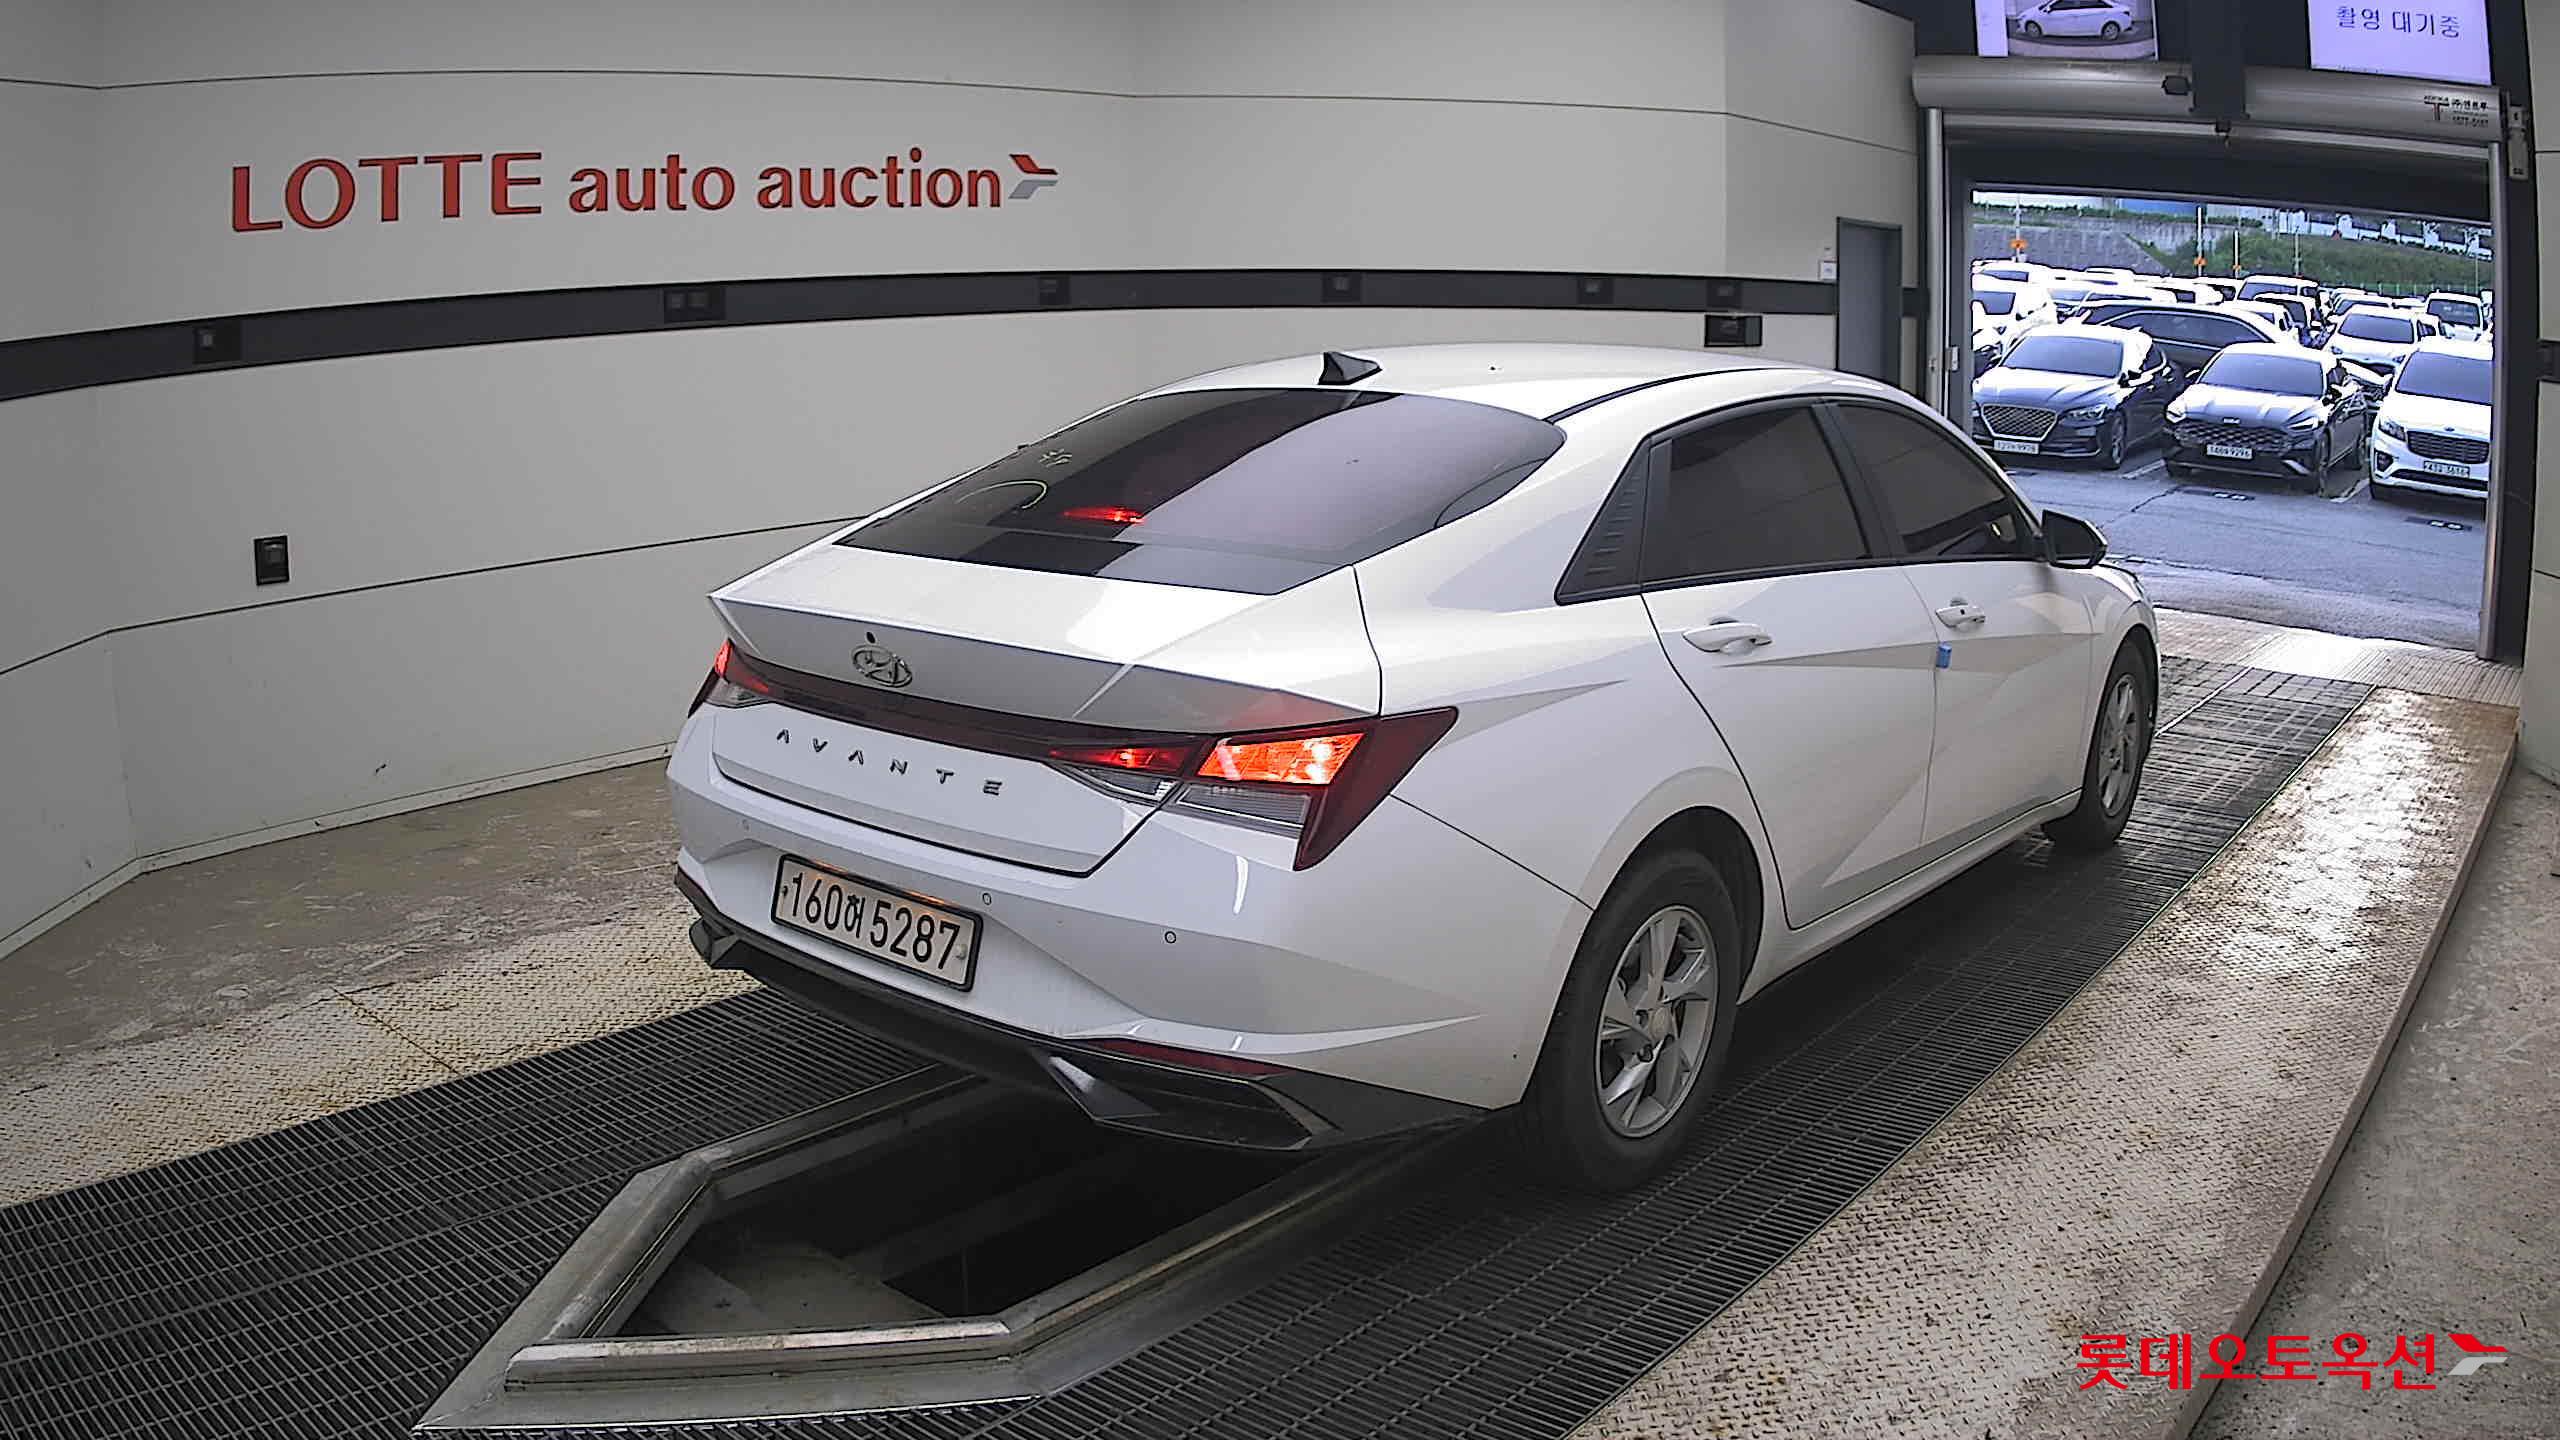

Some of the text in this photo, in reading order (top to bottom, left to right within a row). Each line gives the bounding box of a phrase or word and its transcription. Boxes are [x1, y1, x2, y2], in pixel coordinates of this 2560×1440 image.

[2392, 11, 2460, 39] 대기중
[232, 147, 1001, 233] LOTTE auto auction
[776, 728, 1002, 796] AVANTE
[791, 871, 961, 970] 160허5287
